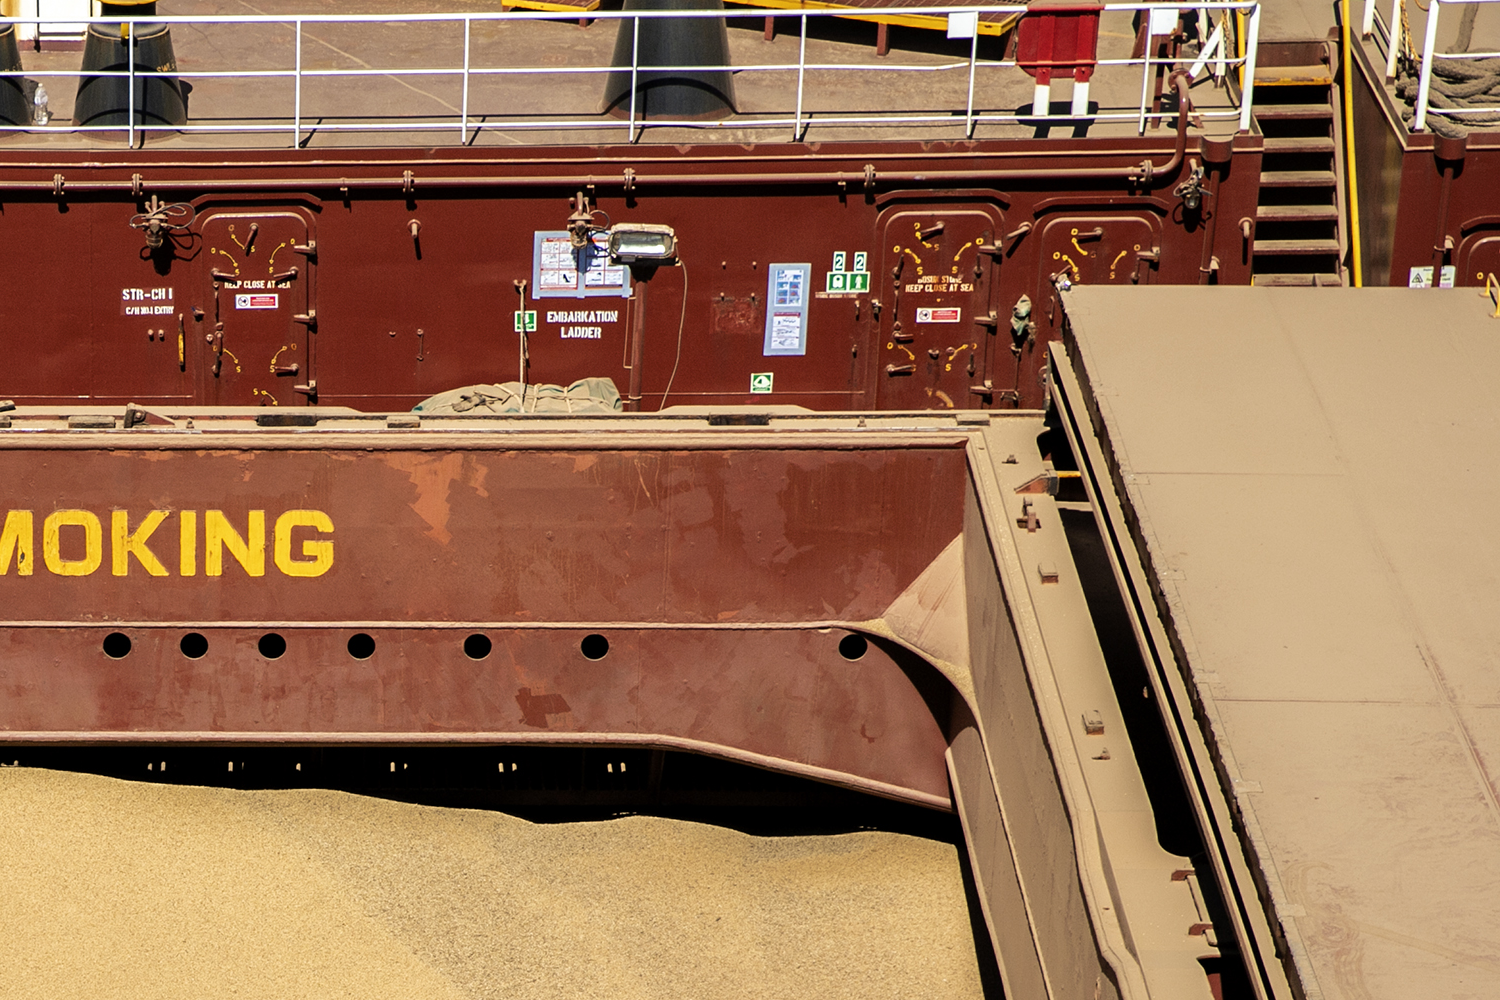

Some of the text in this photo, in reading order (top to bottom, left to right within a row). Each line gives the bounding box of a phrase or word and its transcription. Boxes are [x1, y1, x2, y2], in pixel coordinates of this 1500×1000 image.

[836, 256, 843, 269] 2
[856, 256, 864, 269] 2
[244, 281, 265, 289] CLOSE
[267, 281, 275, 289] AT
[905, 284, 974, 292] KEEP CLOSE AT SEA
[122, 288, 165, 300] STR-CH
[547, 310, 618, 322] EMBARKATION
[561, 327, 602, 338] LADDER
